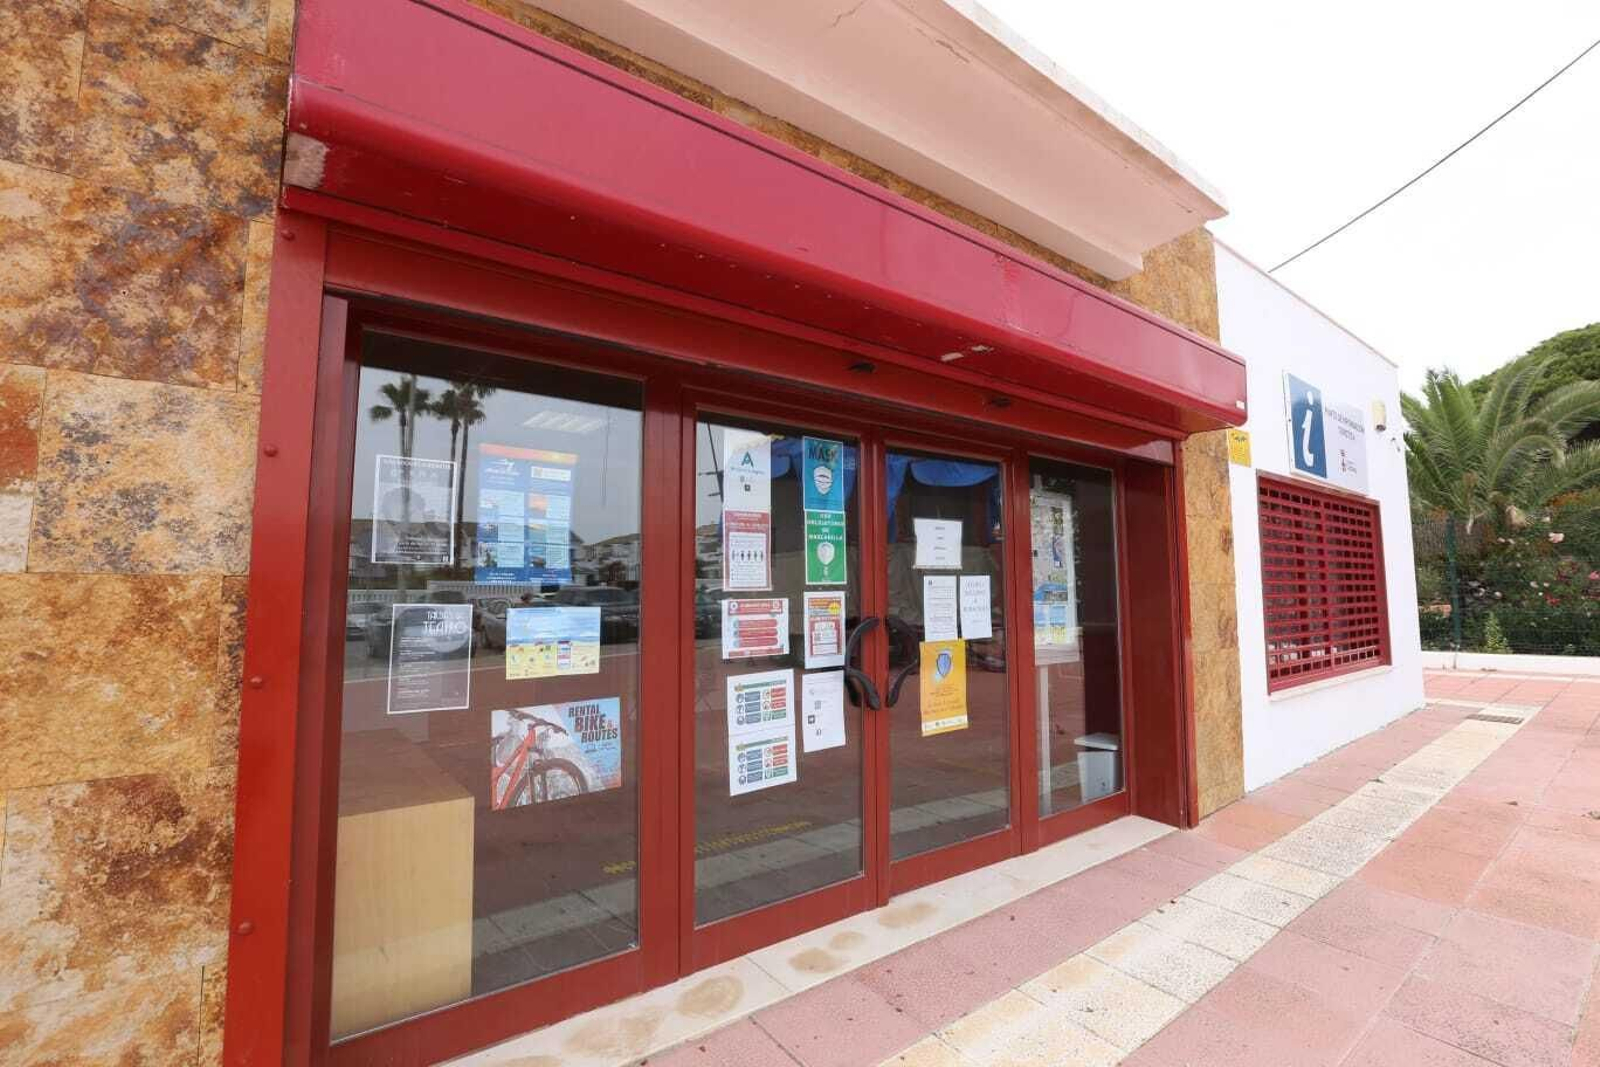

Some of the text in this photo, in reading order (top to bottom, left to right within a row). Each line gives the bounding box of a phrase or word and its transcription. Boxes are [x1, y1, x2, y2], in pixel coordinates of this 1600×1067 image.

[568, 704, 600, 718] RENTAL
[575, 713, 606, 732] BIKE
[581, 728, 618, 743] ROUTES
